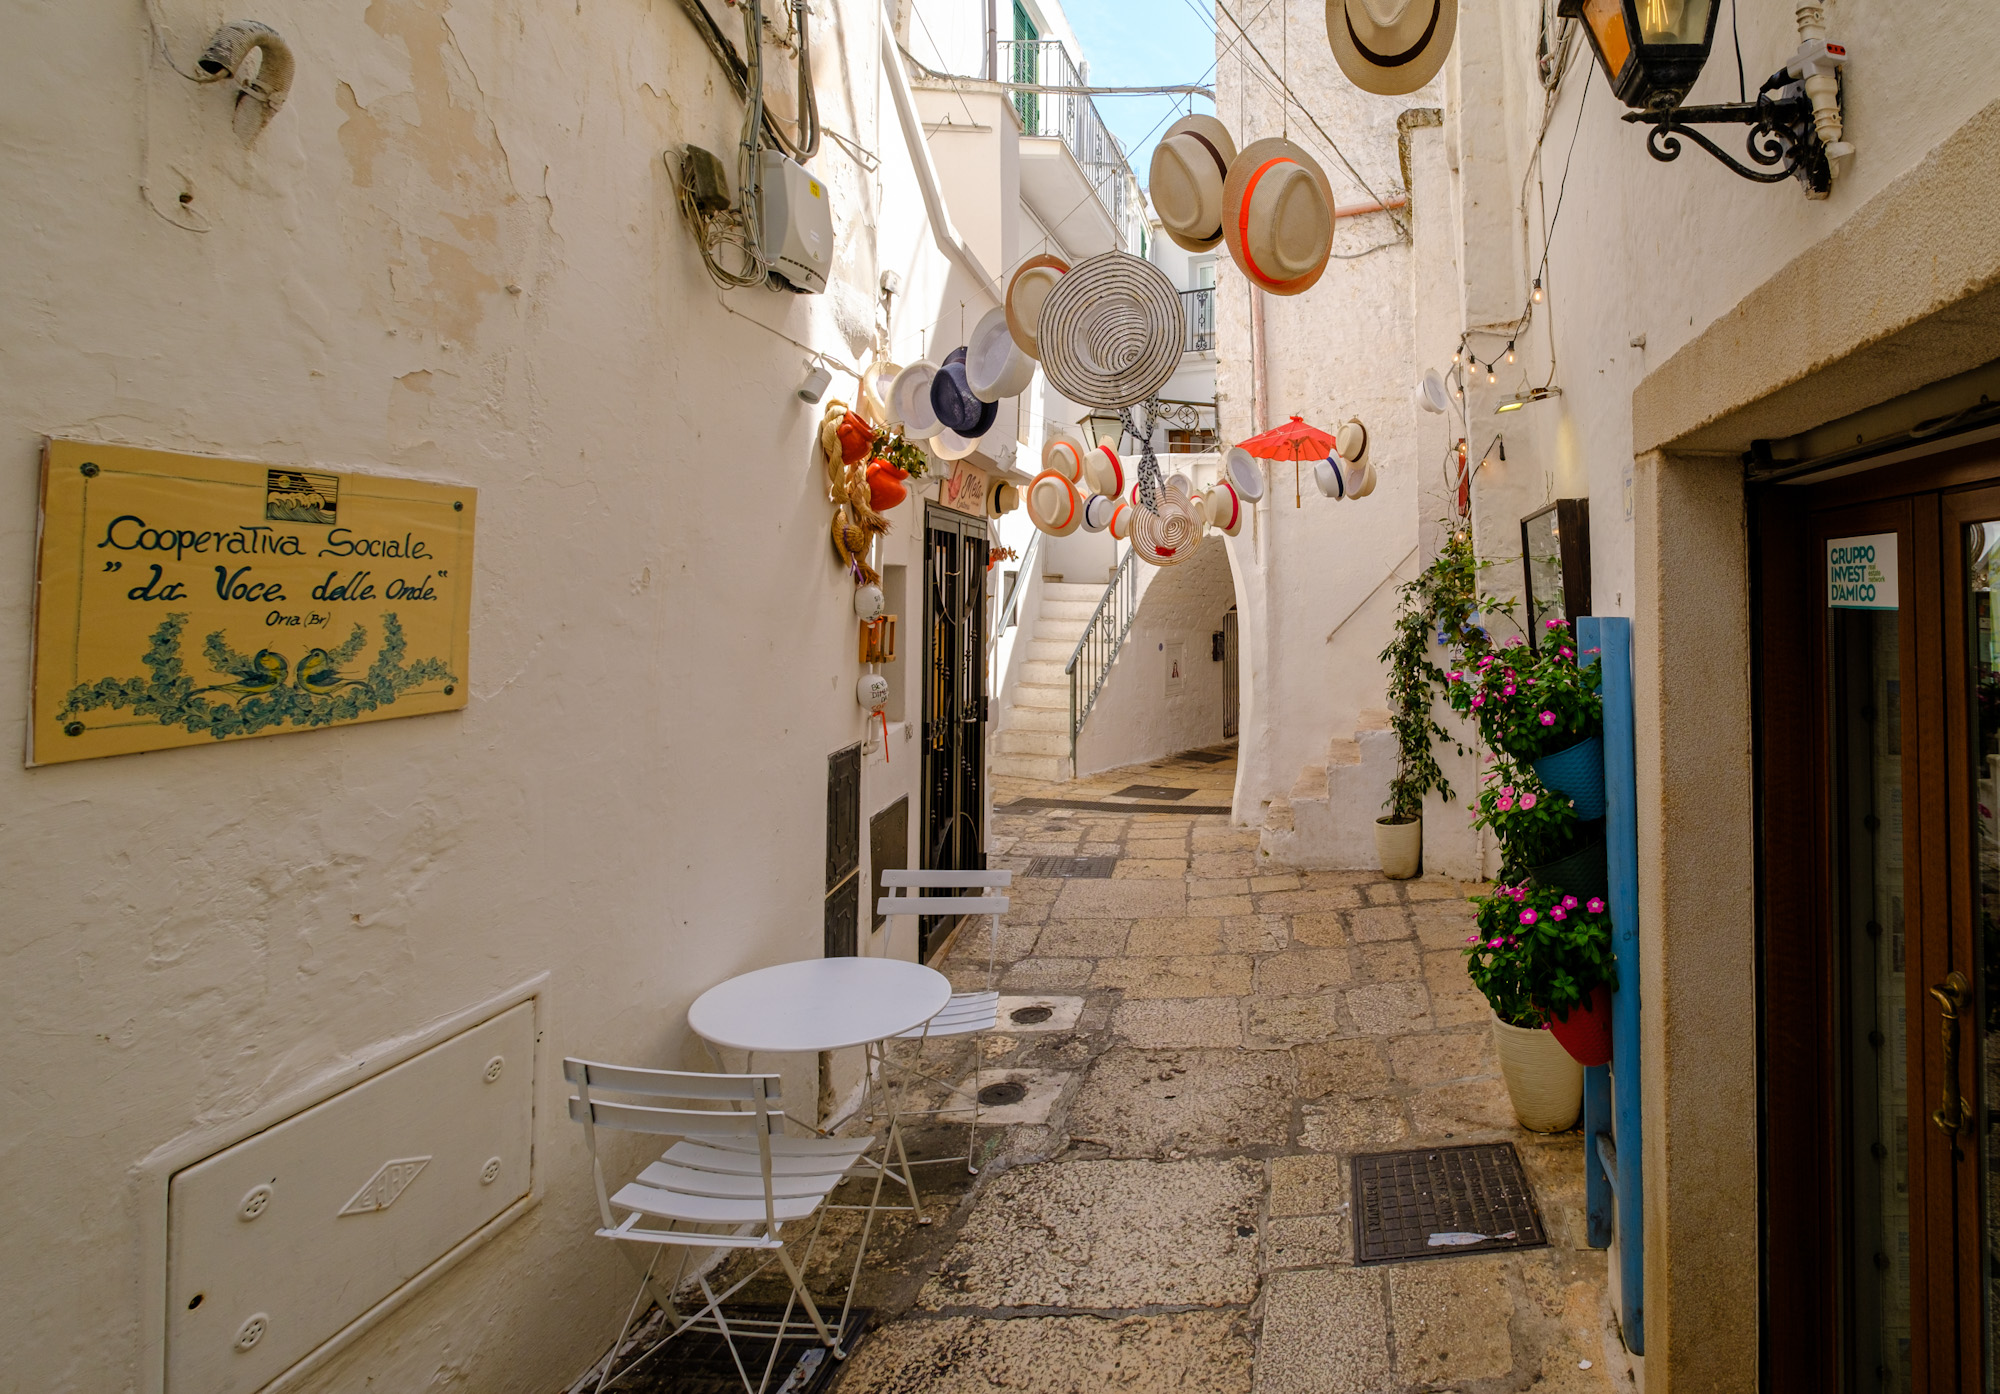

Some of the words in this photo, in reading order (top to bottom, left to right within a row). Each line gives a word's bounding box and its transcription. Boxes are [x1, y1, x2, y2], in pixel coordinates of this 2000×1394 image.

[318, 528, 433, 559] Sociale
[1831, 545, 1875, 565] GRUPPO
[1831, 565, 1867, 582] INVEST
[214, 565, 287, 602] Voce
[312, 571, 376, 601] delle
[1831, 584, 1876, 602] D'AMICO
[265, 610, 301, 627] Oria
[303, 611, 331, 629] (Br)
